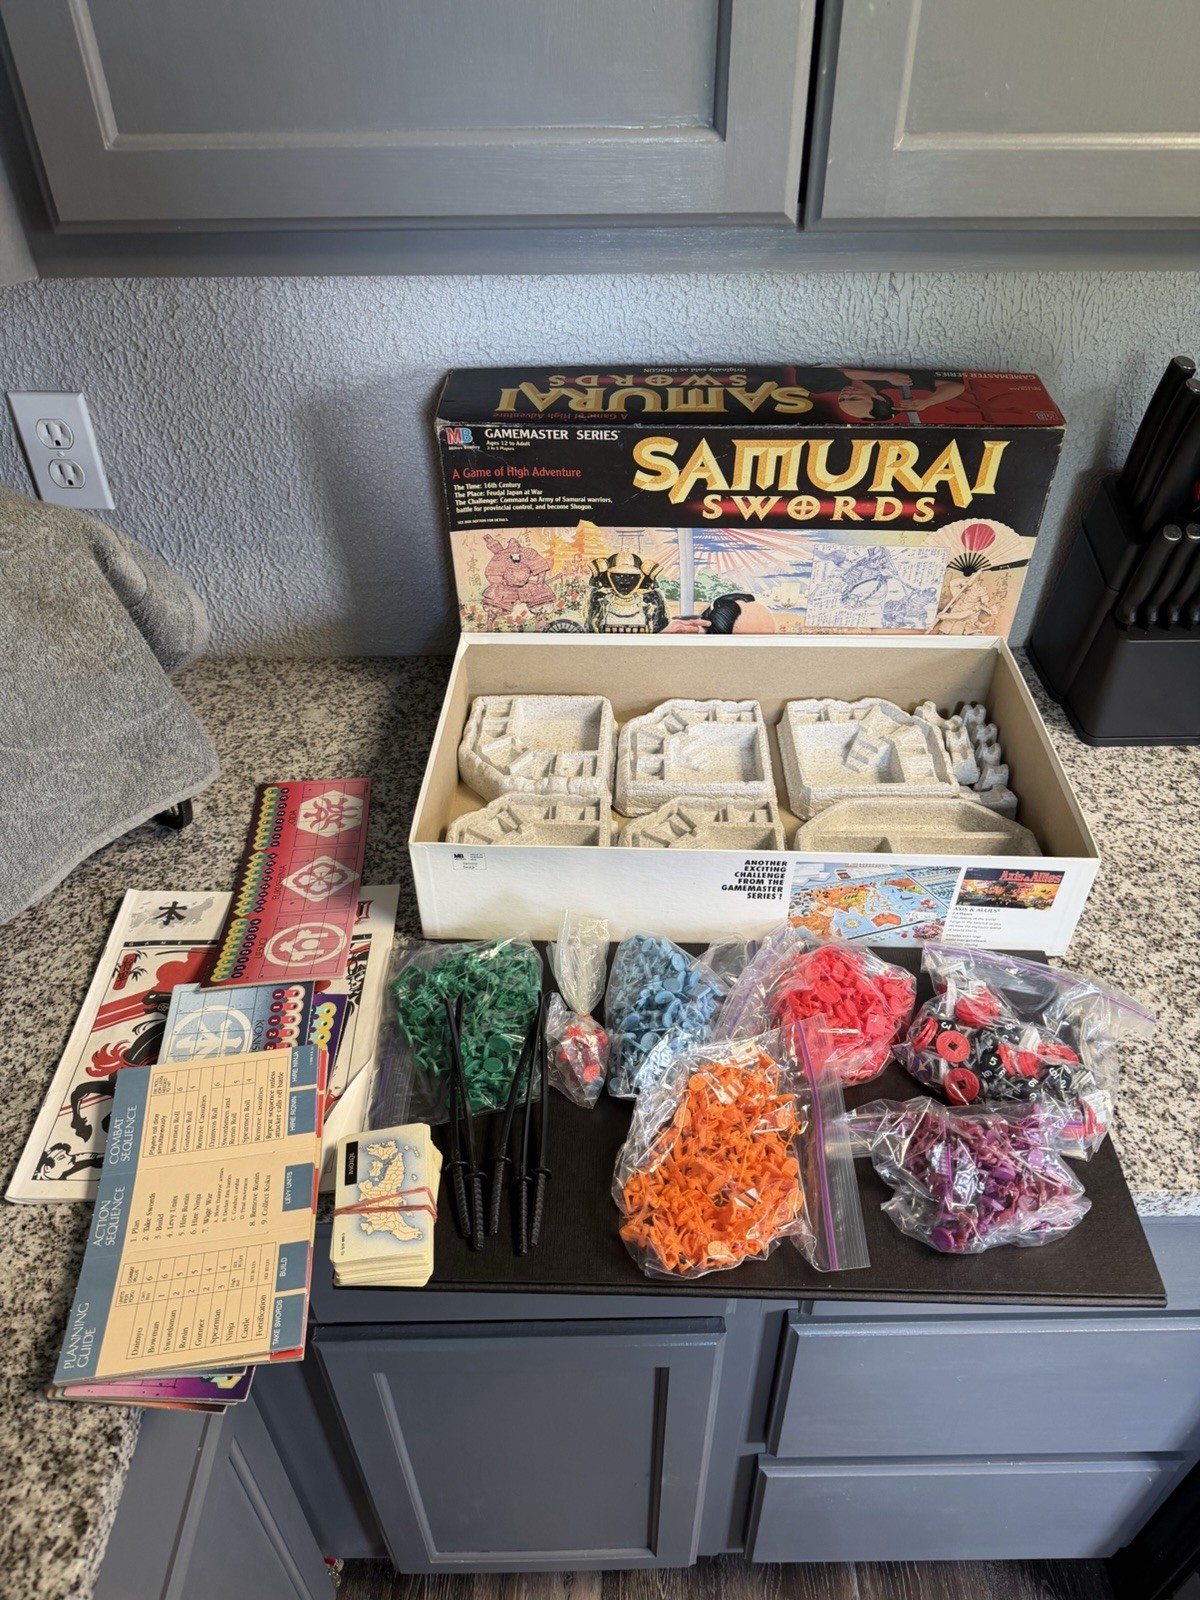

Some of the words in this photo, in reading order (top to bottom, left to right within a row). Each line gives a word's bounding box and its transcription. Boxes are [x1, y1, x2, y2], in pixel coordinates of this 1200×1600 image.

[548, 374, 748, 387] SWORDS
[494, 381, 814, 414] SAMURAI
[445, 427, 474, 445] MB
[484, 428, 569, 440] GAMEMASTER
[576, 430, 619, 440] SERIES
[452, 469, 460, 479] A
[463, 468, 492, 478] Game
[494, 466, 503, 476] of
[507, 466, 529, 478] High
[532, 467, 582, 478] Adventure
[633, 436, 1011, 509] SAMURAI
[702, 494, 936, 523] SWORDS
[288, 809, 297, 824] ODA
[1000, 870, 1026, 880] Axis
[153, 901, 188, 926] 本
[989, 1056, 998, 1066] 5
[1060, 1080, 1066, 1089] 2
[267, 1089, 275, 1117] sequence
[120, 1104, 138, 1162] SEQUENCE
[156, 1115, 167, 1154] simultaneously
[170, 1124, 178, 1152] Bowmen
[182, 1124, 191, 1151] Gunners
[220, 1110, 229, 1145] Swordsmen
[241, 1112, 250, 1142] Spearmen
[265, 1118, 274, 1139] Repeat
[108, 1116, 125, 1164] COMBAT
[148, 1135, 157, 1155] Players
[145, 1192, 156, 1216] Swords
[169, 1195, 178, 1212] Units
[181, 1192, 190, 1212] Ronin
[193, 1193, 202, 1210] Ninja
[250, 1192, 258, 1217] Remove
[91, 1199, 111, 1247] ACTION
[104, 1185, 125, 1246] SEQUENCE
[131, 1219, 140, 1234] Plan
[142, 1217, 152, 1232] Take
[155, 1212, 164, 1231] Build
[166, 1213, 177, 1229] Levy
[179, 1213, 187, 1227] Hire
[191, 1212, 199, 1226] Hire
[202, 1206, 212, 1224] Wage
[279, 1256, 287, 1276] BUILD
[256, 1294, 266, 1336] Fortification
[274, 1299, 282, 1327] SWORDS
[62, 1302, 90, 1369] PLANNING
[147, 1321, 159, 1353] Bowman
[163, 1309, 176, 1351] Swordsman
[178, 1326, 189, 1348] Ronin
[194, 1318, 205, 1346] Gunner
[210, 1308, 222, 1343] Spearman
[225, 1321, 235, 1341] Ninja
[240, 1317, 250, 1339] Castle
[272, 1328, 280, 1345] TAKE
[76, 1327, 96, 1368] GUIDE
[130, 1327, 144, 1355] Daimyo
